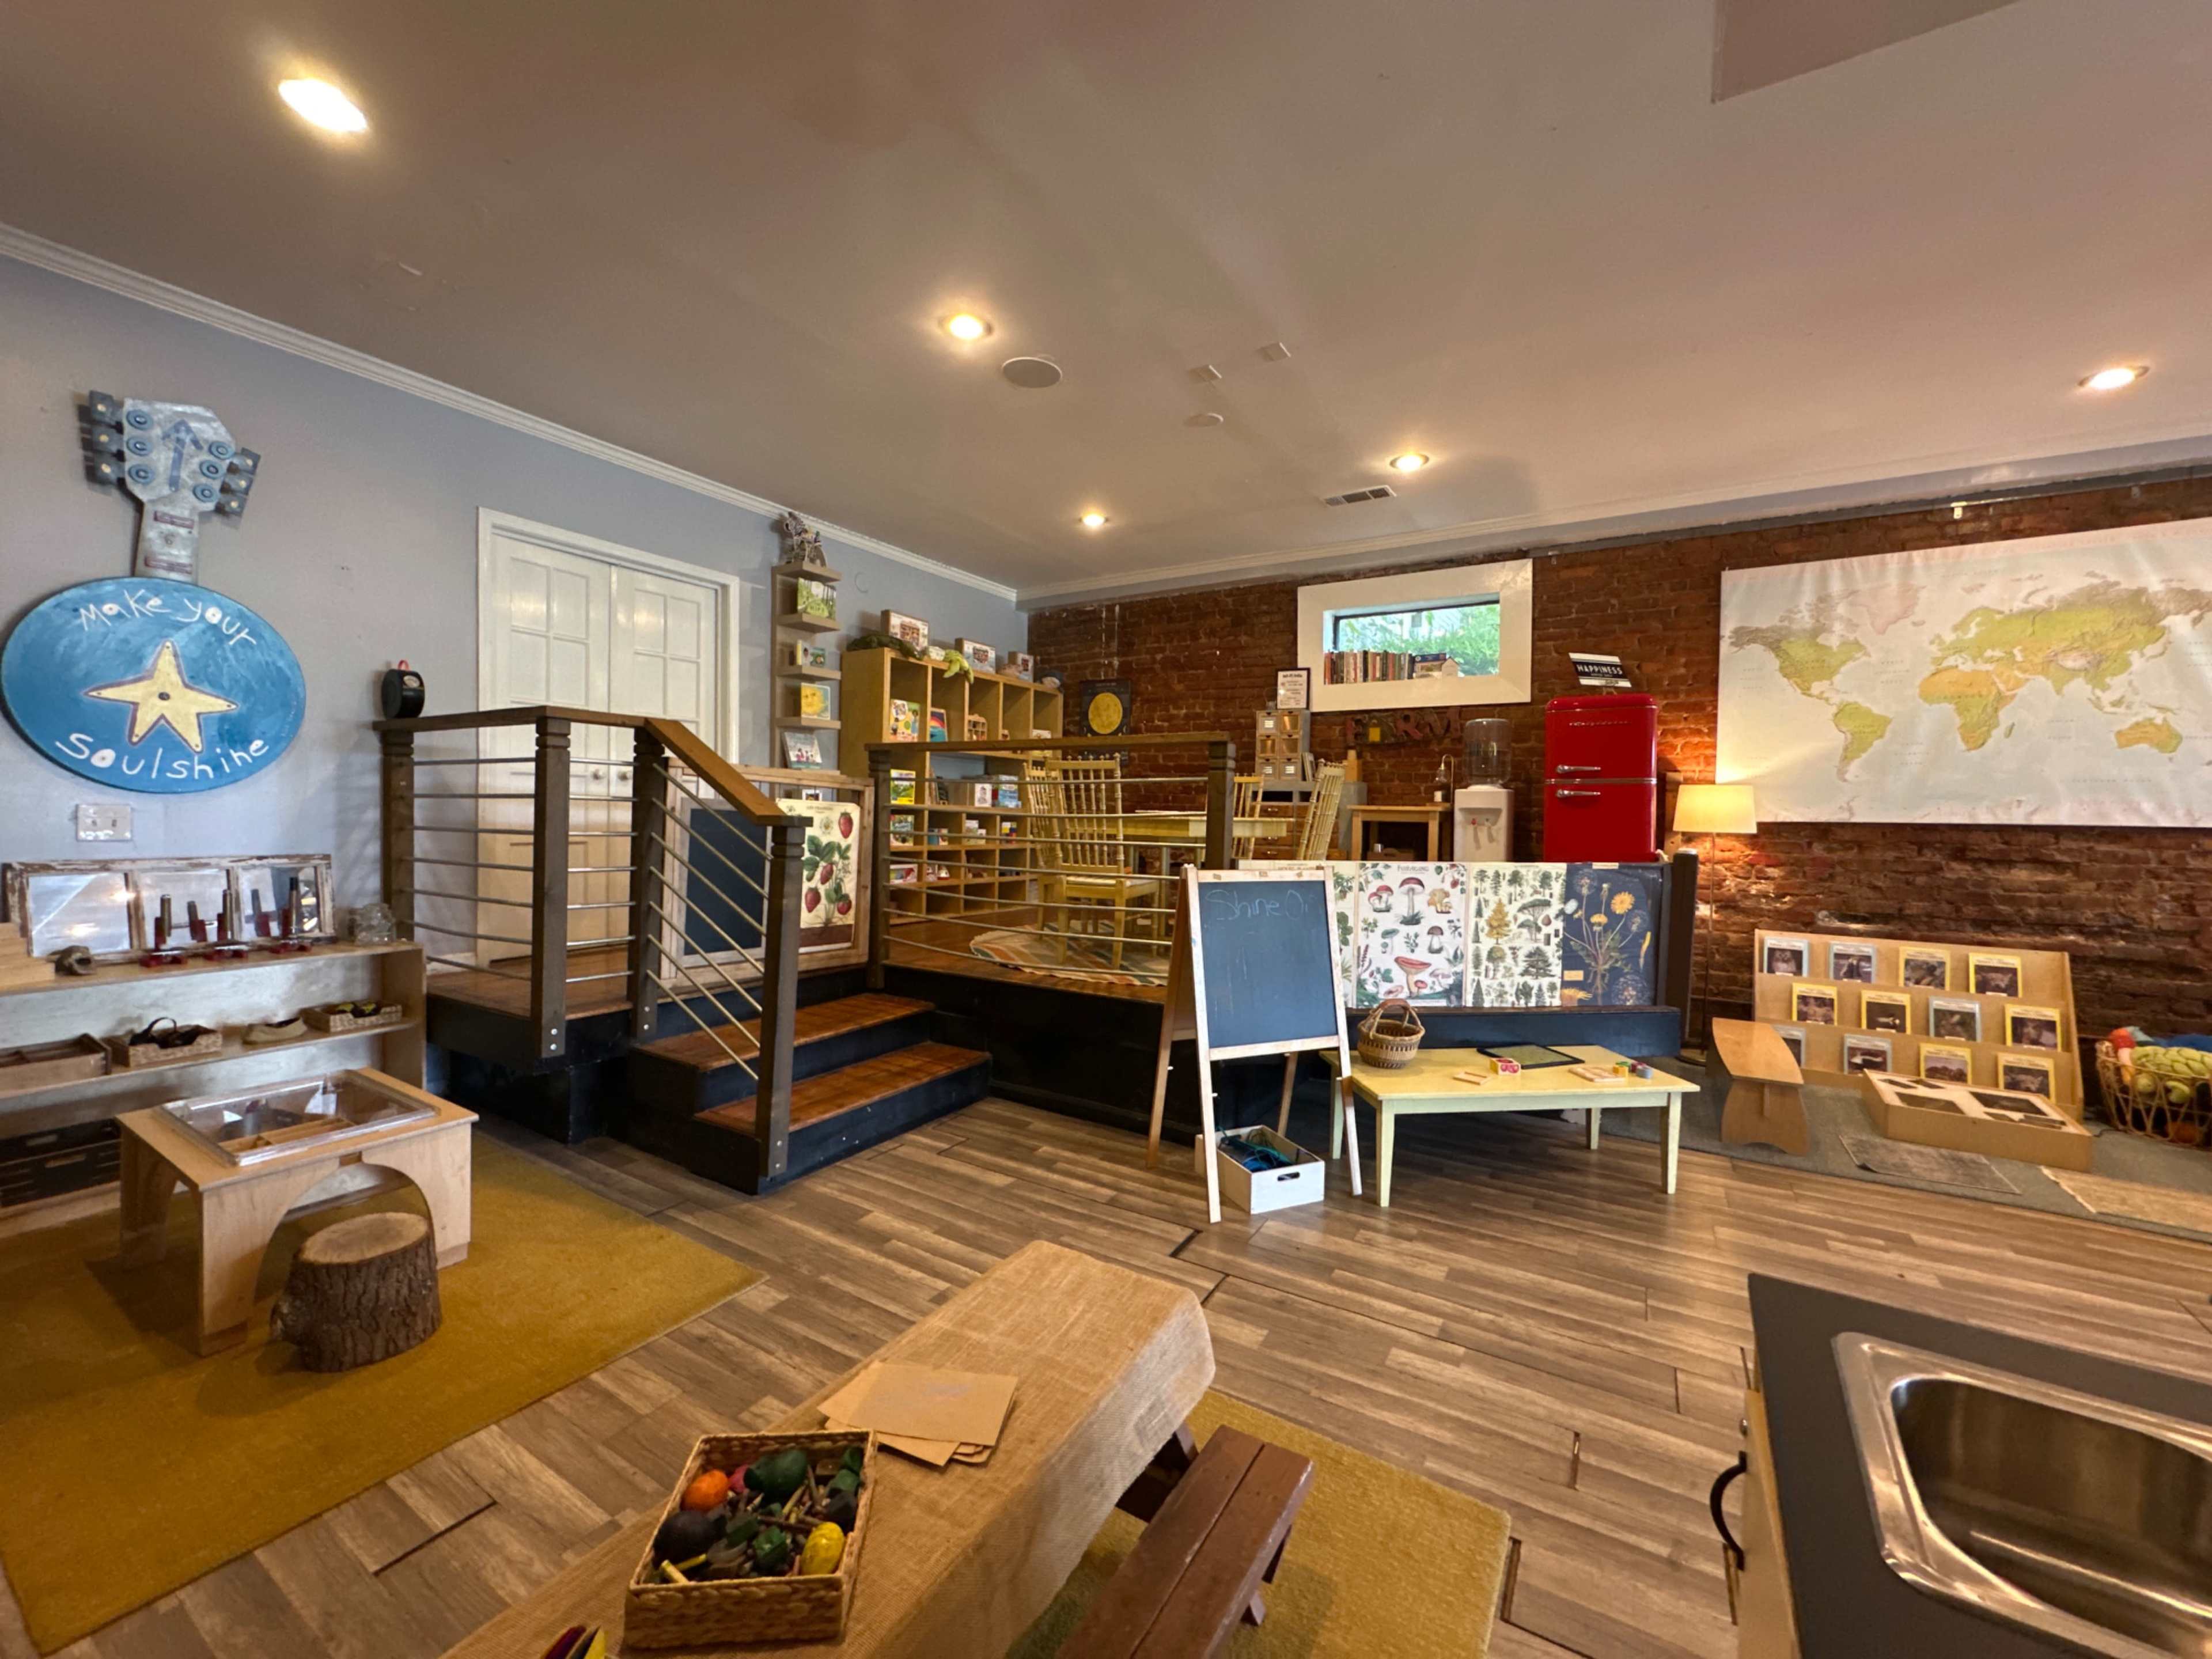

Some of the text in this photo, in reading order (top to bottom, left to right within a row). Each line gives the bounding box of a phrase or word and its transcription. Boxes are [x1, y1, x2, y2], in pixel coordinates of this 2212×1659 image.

[79, 589, 257, 646] Make your
[1576, 664, 1623, 675] HAPPINESS
[56, 733, 269, 779] Soulshine
[1205, 889, 1282, 921] Shine
